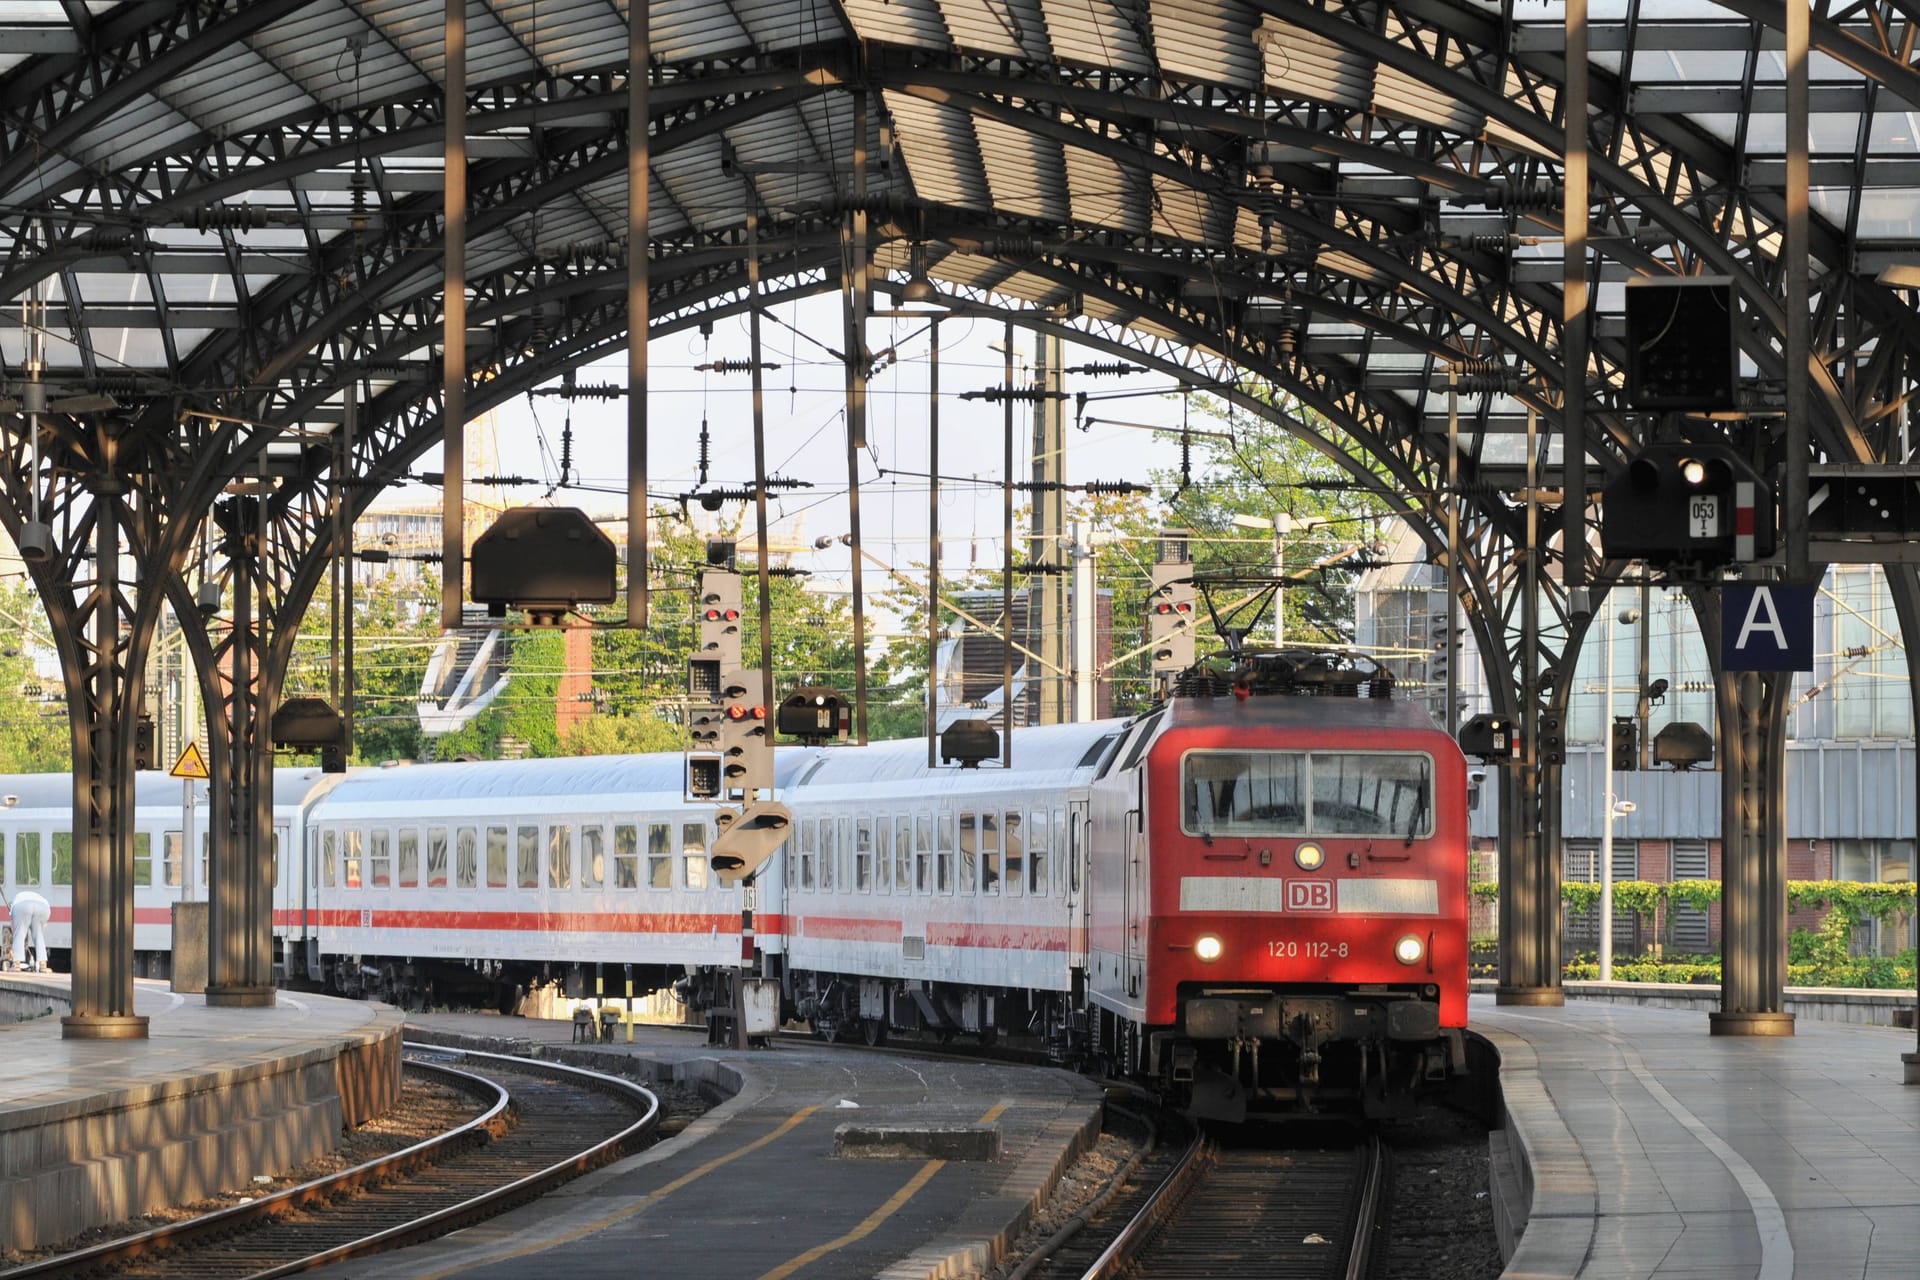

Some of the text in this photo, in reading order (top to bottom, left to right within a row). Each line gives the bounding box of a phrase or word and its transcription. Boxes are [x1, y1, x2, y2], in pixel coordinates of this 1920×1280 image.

[1693, 503, 1714, 519] 053
[1735, 586, 1789, 650] A
[1292, 885, 1328, 906] DB
[1268, 941, 1349, 958] 120 112-8
